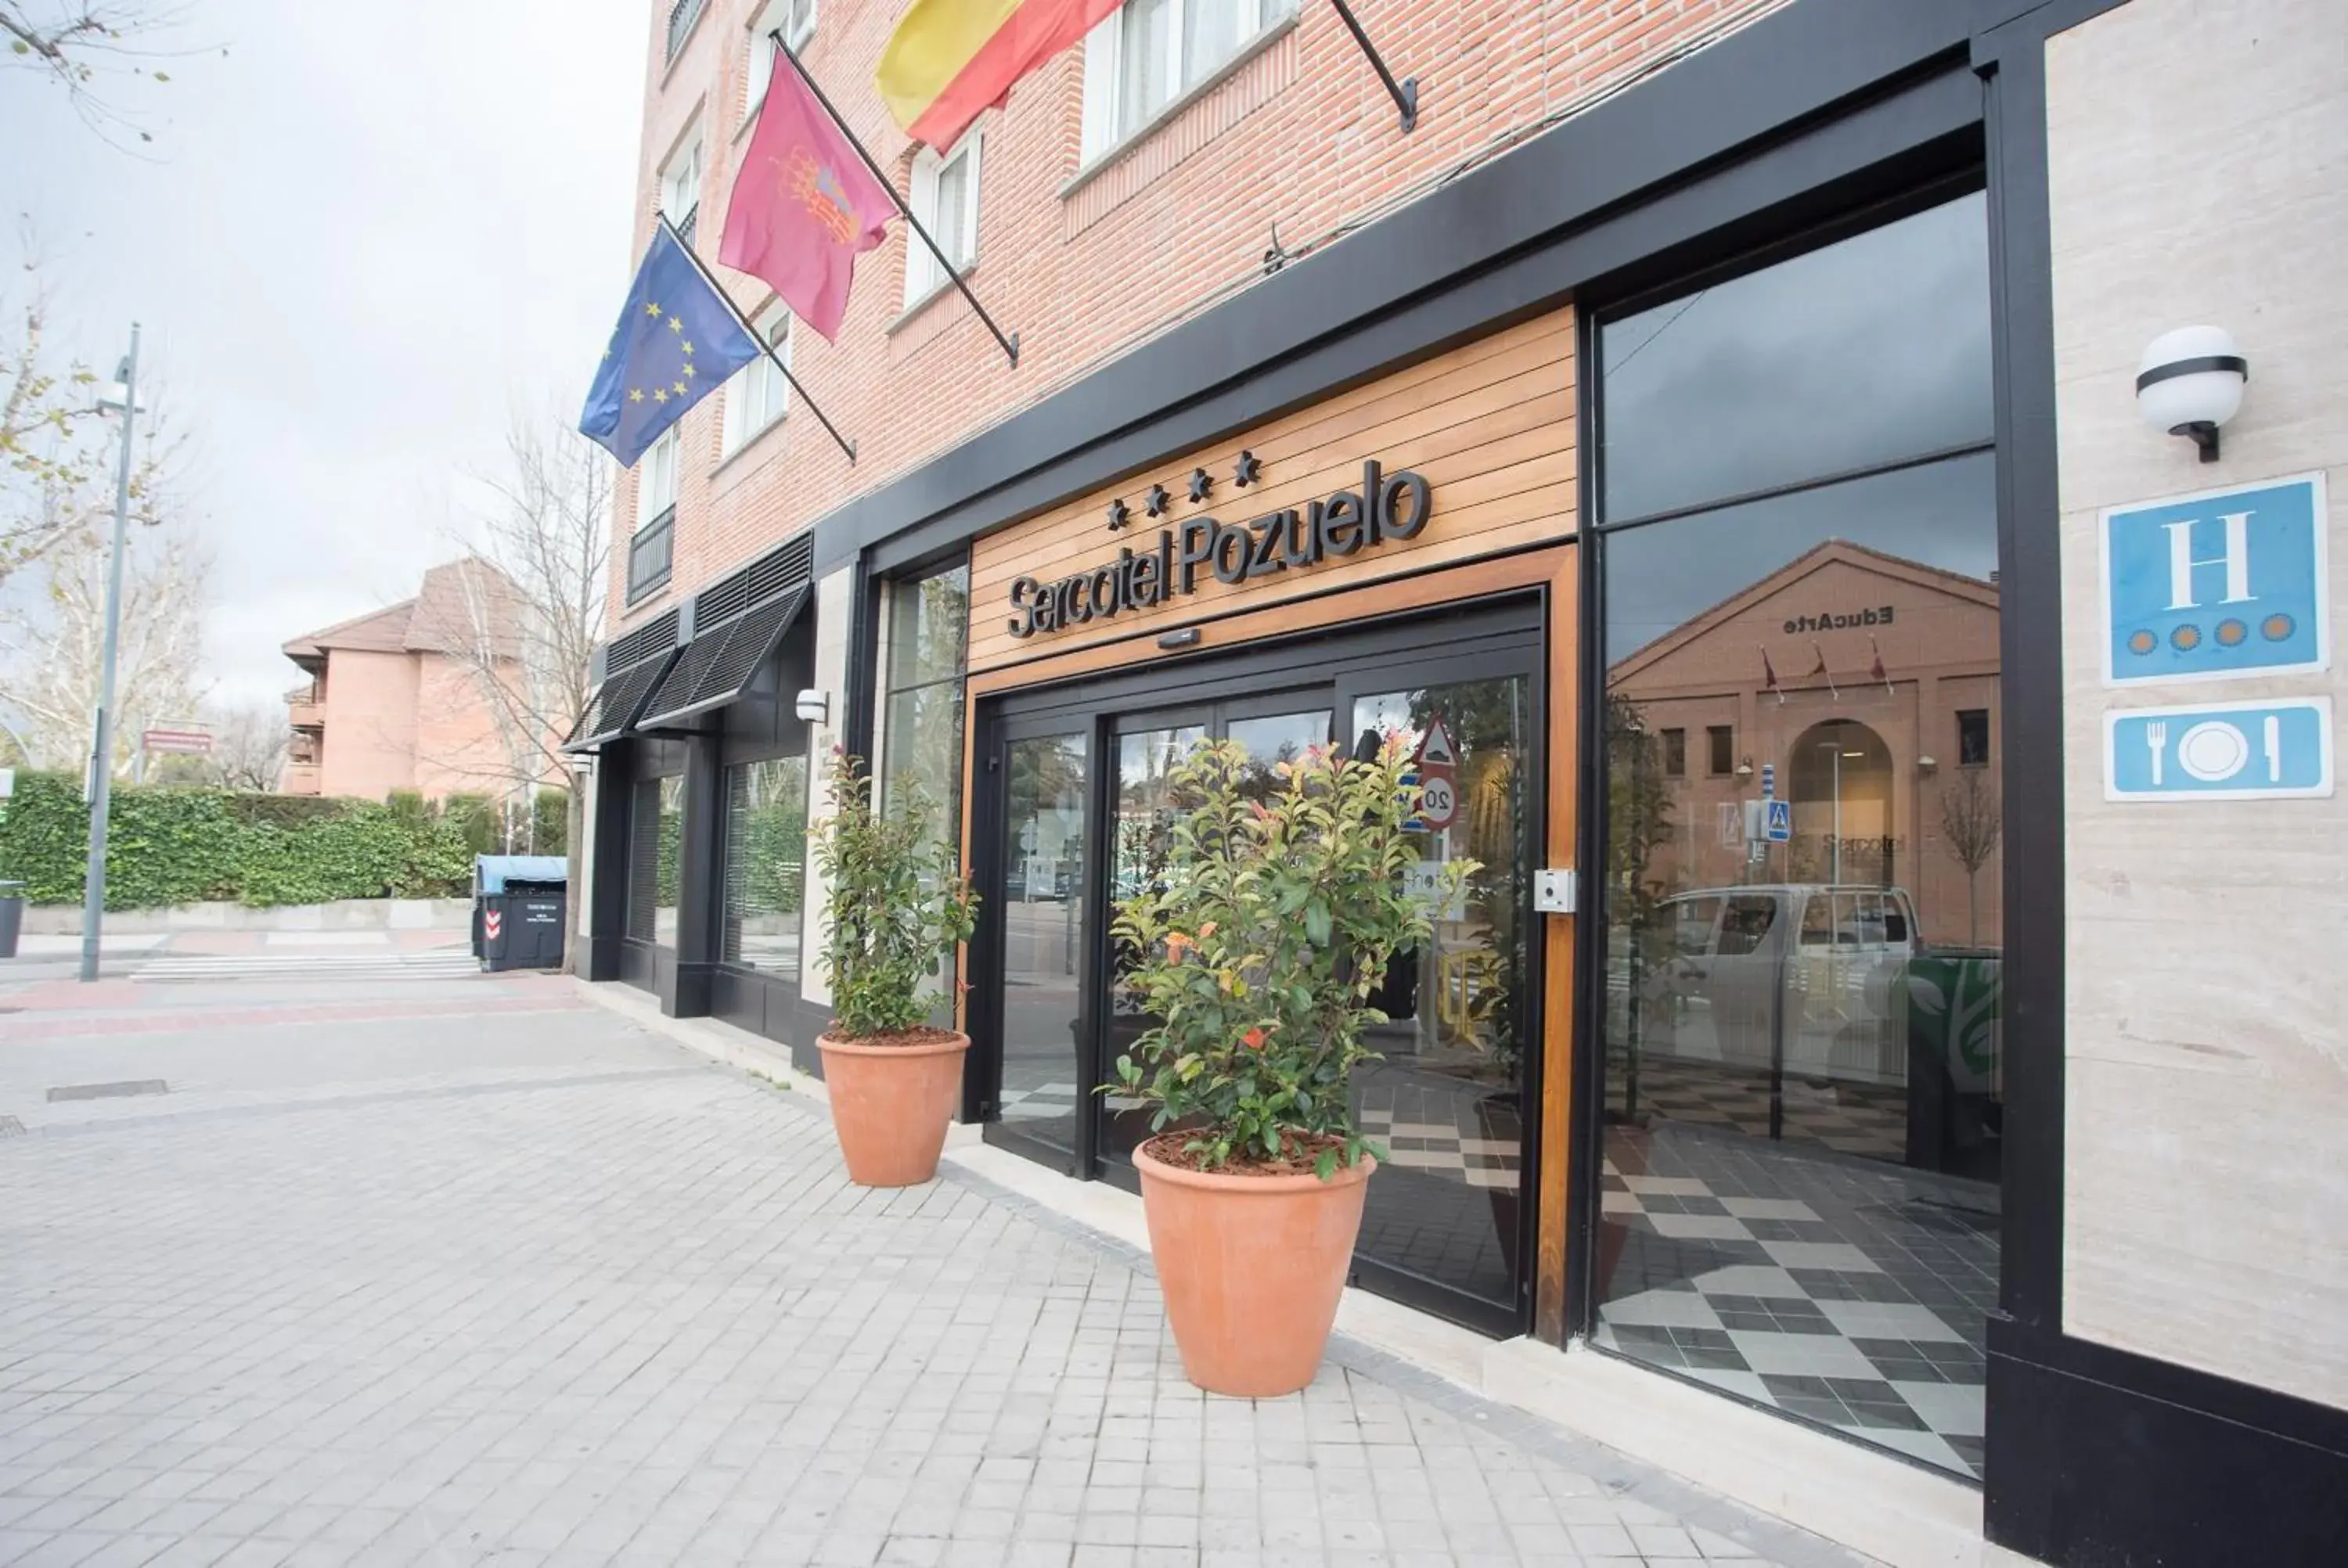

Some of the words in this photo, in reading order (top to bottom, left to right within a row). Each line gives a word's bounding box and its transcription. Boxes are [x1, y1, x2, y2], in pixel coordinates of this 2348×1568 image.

[1007, 530, 1172, 639] Sercotel
[1178, 459, 1433, 595] Pozuelo
[2159, 509, 2260, 611] H
